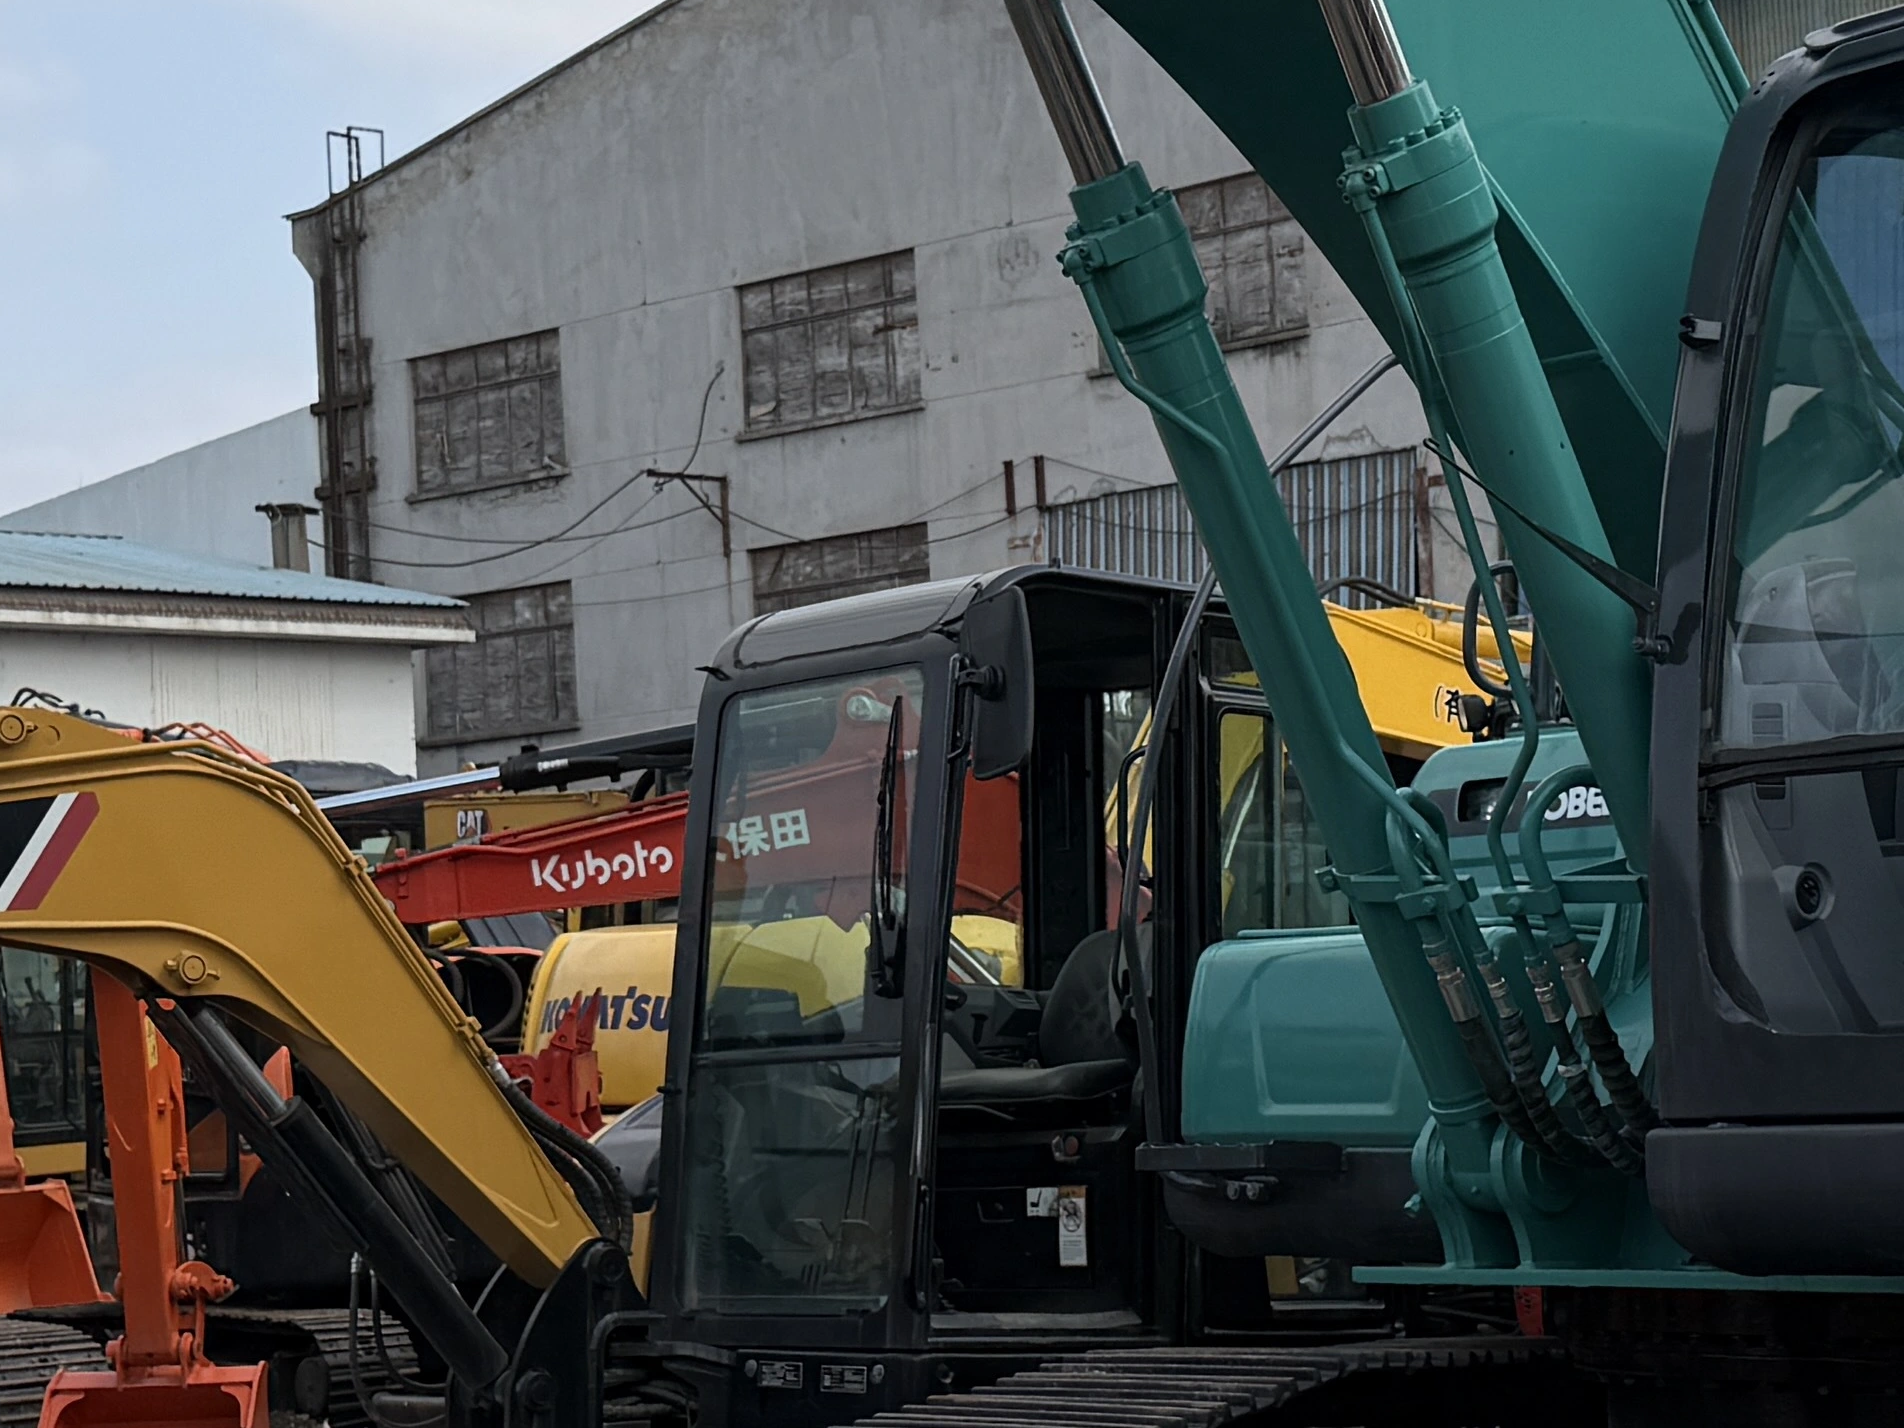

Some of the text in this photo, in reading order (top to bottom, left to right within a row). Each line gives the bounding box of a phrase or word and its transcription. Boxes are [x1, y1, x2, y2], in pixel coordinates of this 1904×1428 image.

[457, 809, 484, 839] CAT
[716, 808, 811, 862] 保田
[531, 840, 674, 893] Kubota
